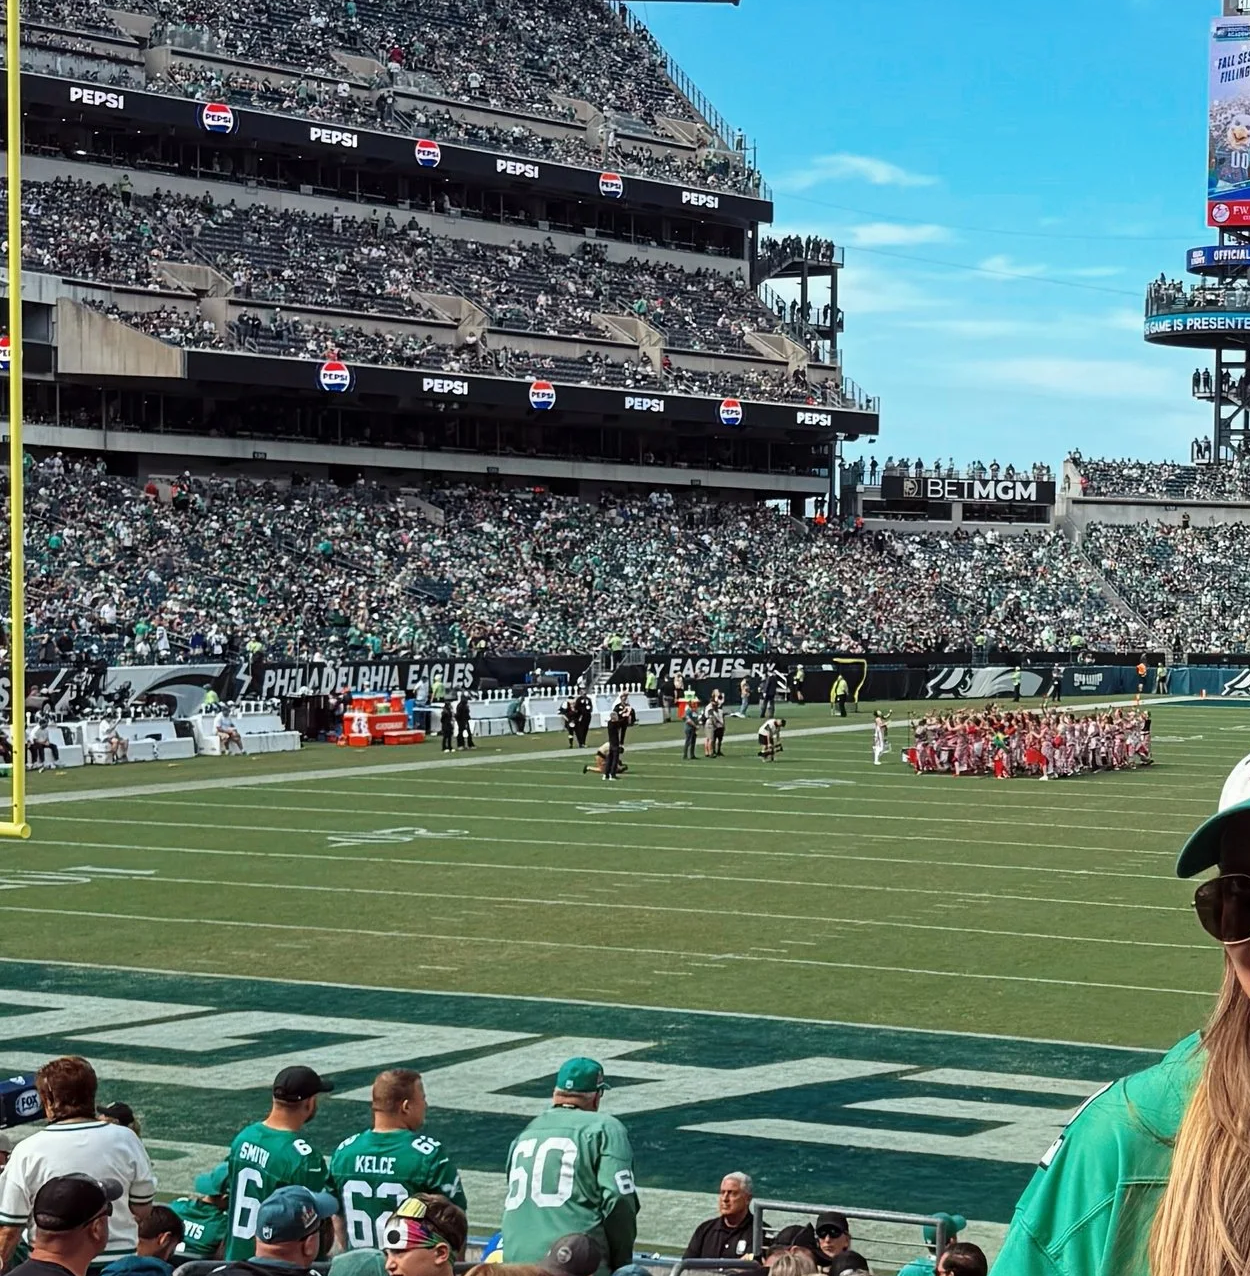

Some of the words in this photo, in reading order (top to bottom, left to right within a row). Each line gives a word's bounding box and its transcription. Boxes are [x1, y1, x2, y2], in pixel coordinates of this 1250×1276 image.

[1218, 55, 1235, 69] FALL
[1220, 65, 1250, 83] FILLING
[70, 87, 124, 110] PEPSI
[205, 112, 231, 123] PEPSI
[310, 127, 358, 148] PEPSI
[417, 149, 439, 158] PEPSI
[496, 159, 539, 178] PEPSI
[601, 181, 621, 190] PEPSI
[682, 191, 719, 209] PEPSI
[1214, 248, 1250, 261] OFFICIAL
[1150, 321, 1172, 333] GAME
[1174, 319, 1183, 330] IS
[323, 373, 347, 381] PEPSI
[423, 378, 468, 395] PEPSI
[531, 392, 553, 400] PEPSI
[625, 397, 664, 412] PEPSI
[797, 412, 831, 426] PEPSI
[928, 479, 1037, 501] BETMGM
[669, 658, 746, 678] EAGLES
[262, 666, 399, 698] PHILADELPHIA
[407, 663, 474, 690] EAGLES
[21, 1095, 37, 1107] FOX
[239, 1141, 270, 1168] SMITH
[355, 1155, 396, 1176] KELCE
[505, 1137, 578, 1211] 60
[232, 1167, 263, 1240] 6
